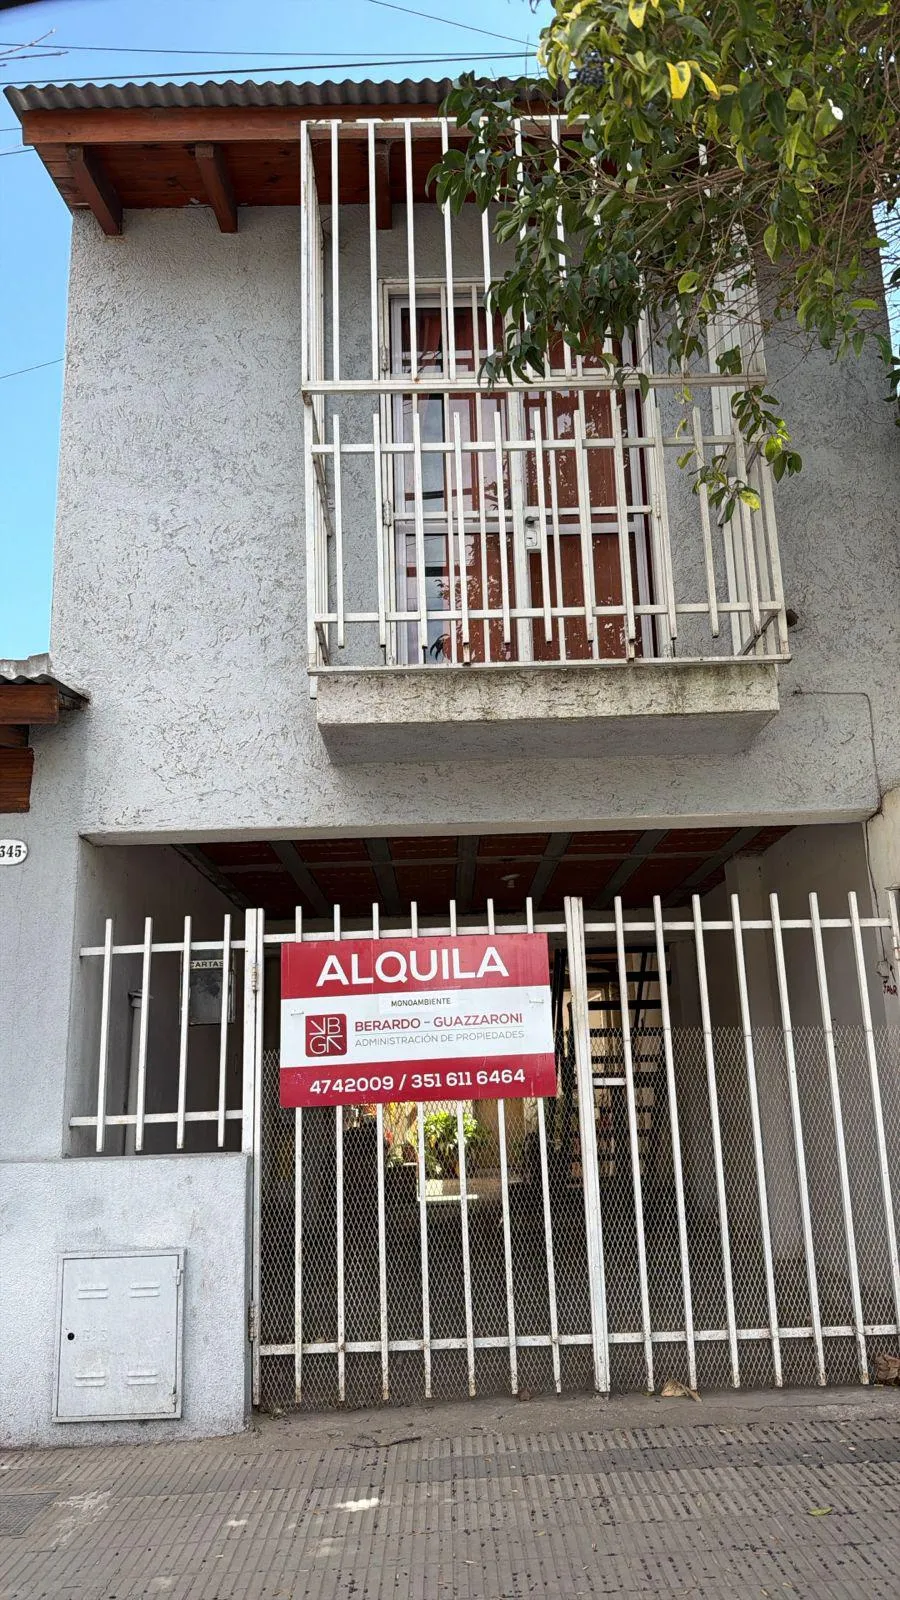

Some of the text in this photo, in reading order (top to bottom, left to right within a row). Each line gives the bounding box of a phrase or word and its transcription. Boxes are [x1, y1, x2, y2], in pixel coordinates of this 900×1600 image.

[315, 946, 509, 987] ALQUILA
[390, 997, 451, 1008] MONOAMBIENTE
[354, 1018, 421, 1032] BERARDO
[433, 1013, 523, 1028] GUAZZARONI
[354, 1030, 525, 1048] ADMINISTRACIÓN DE PROPIEDADES
[309, 1069, 526, 1095] 4742009 / 351 611 6464
